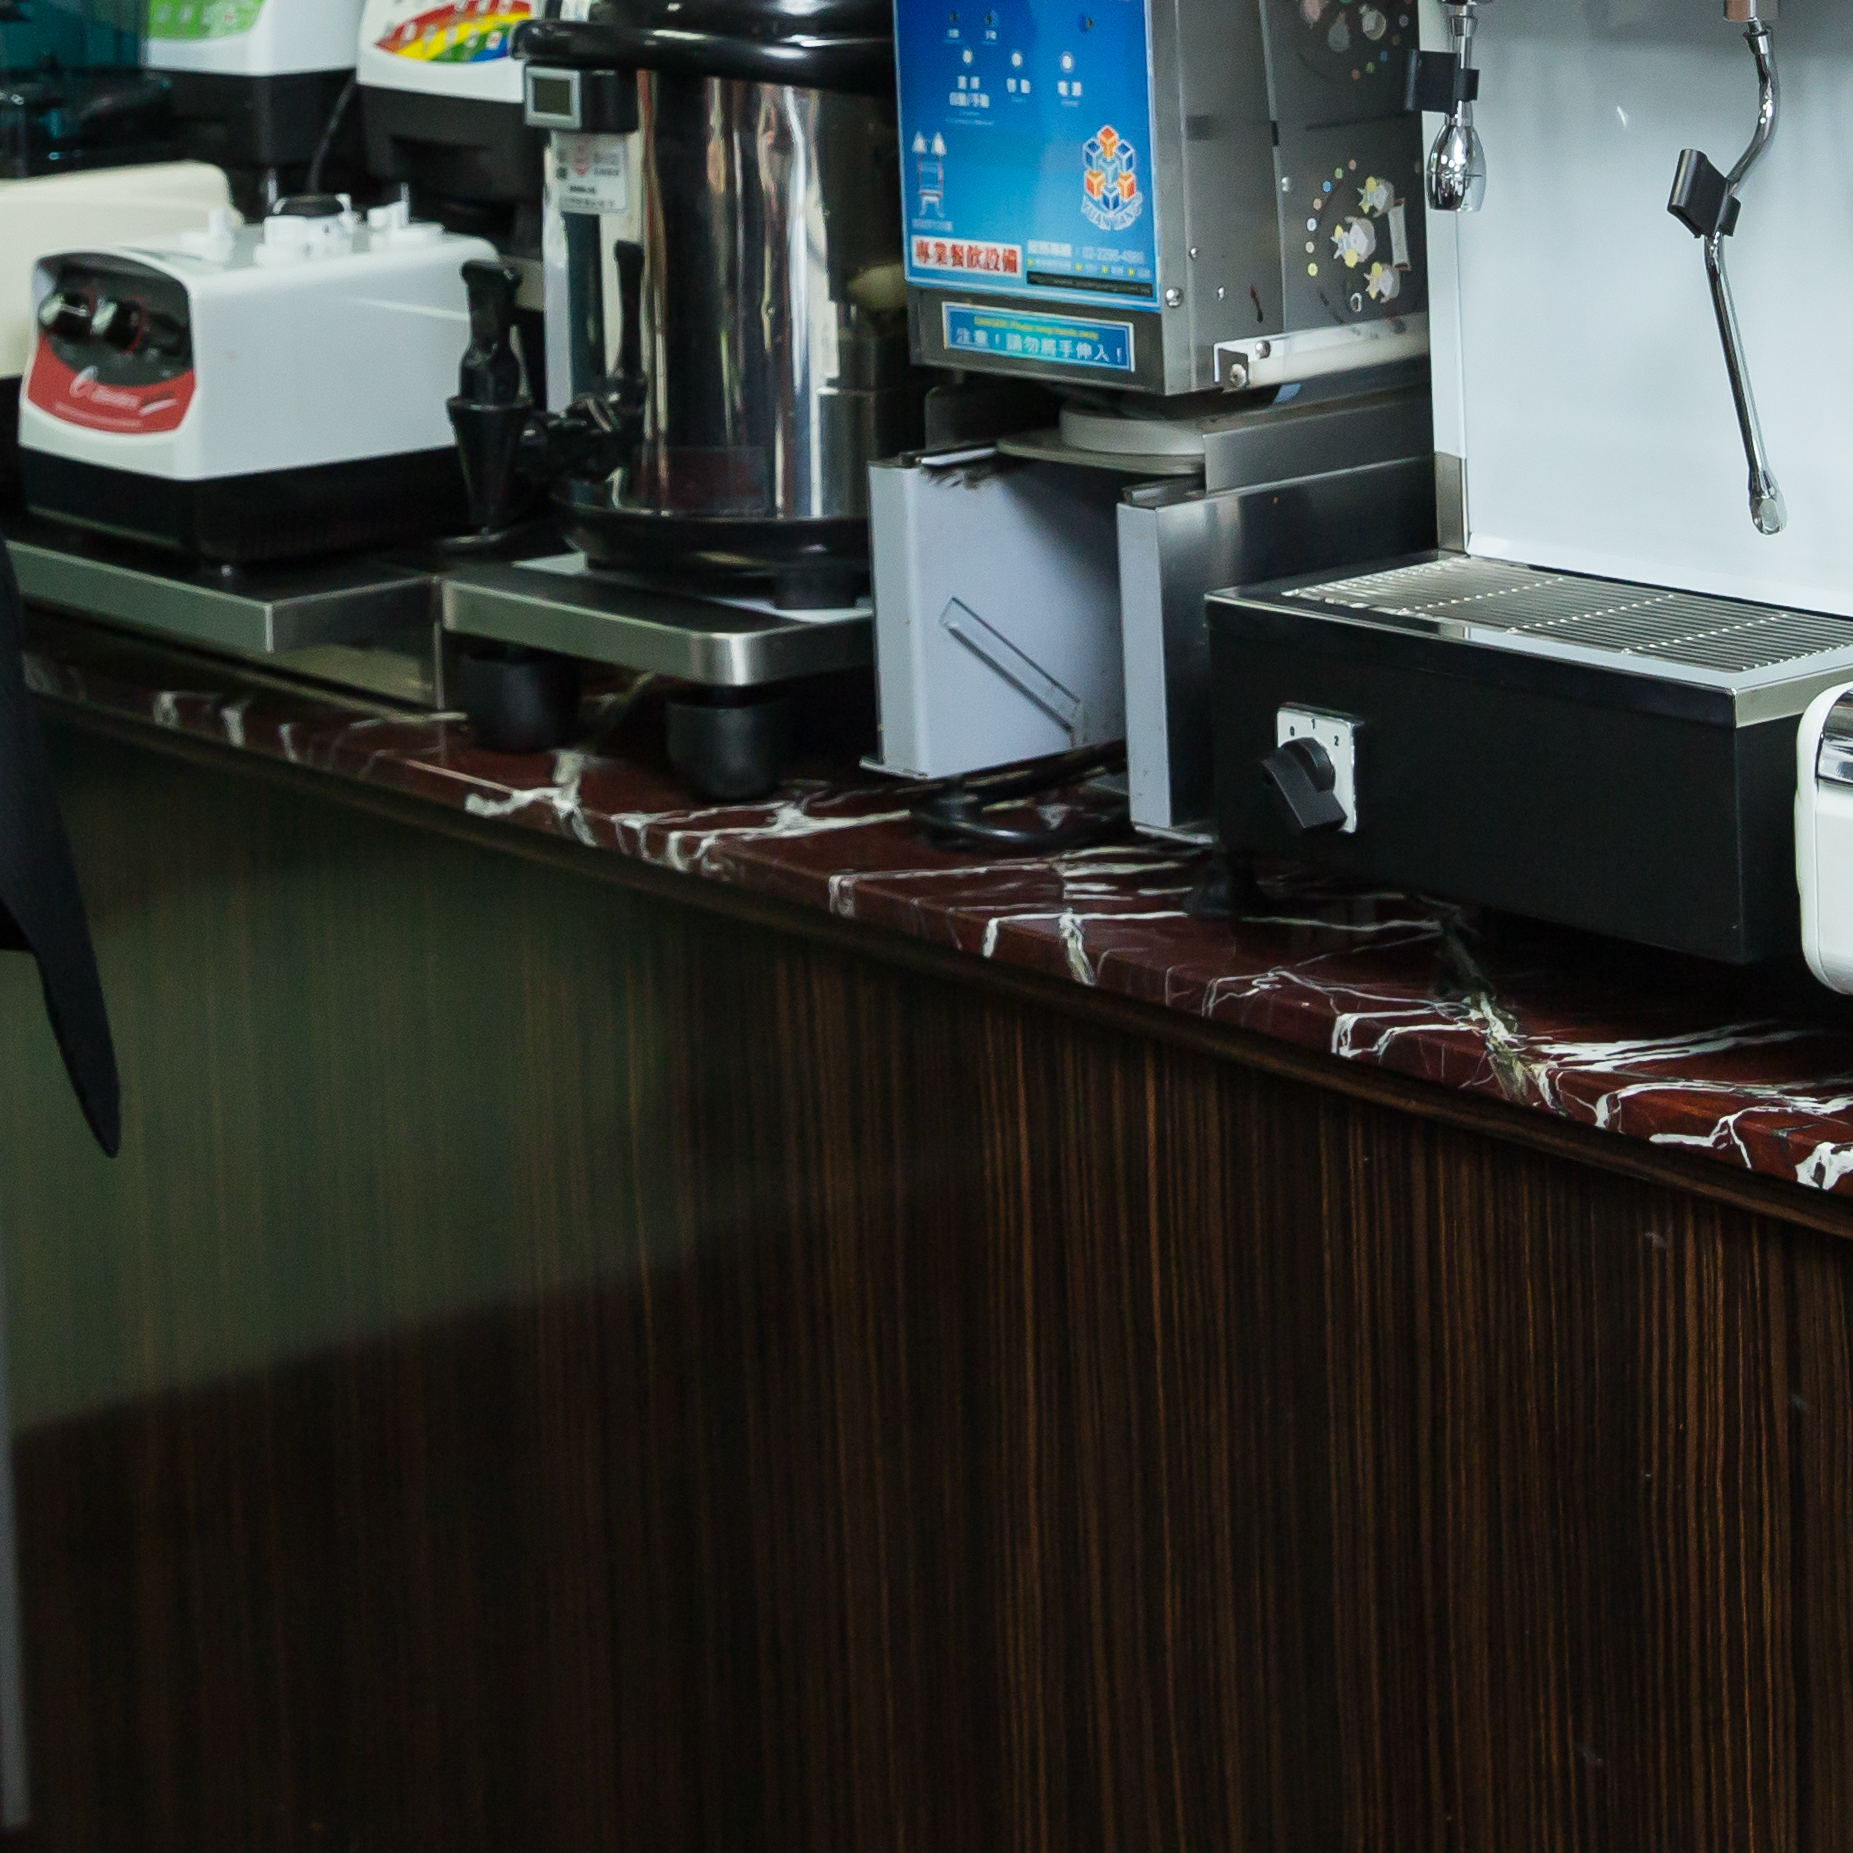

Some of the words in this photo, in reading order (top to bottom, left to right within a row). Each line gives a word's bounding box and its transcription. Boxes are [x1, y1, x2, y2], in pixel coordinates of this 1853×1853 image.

[916, 240, 1018, 274] 專業餐飲設備
[1290, 726, 1295, 737] 0
[1311, 718, 1316, 730] 1
[1334, 735, 1339, 747] 2
